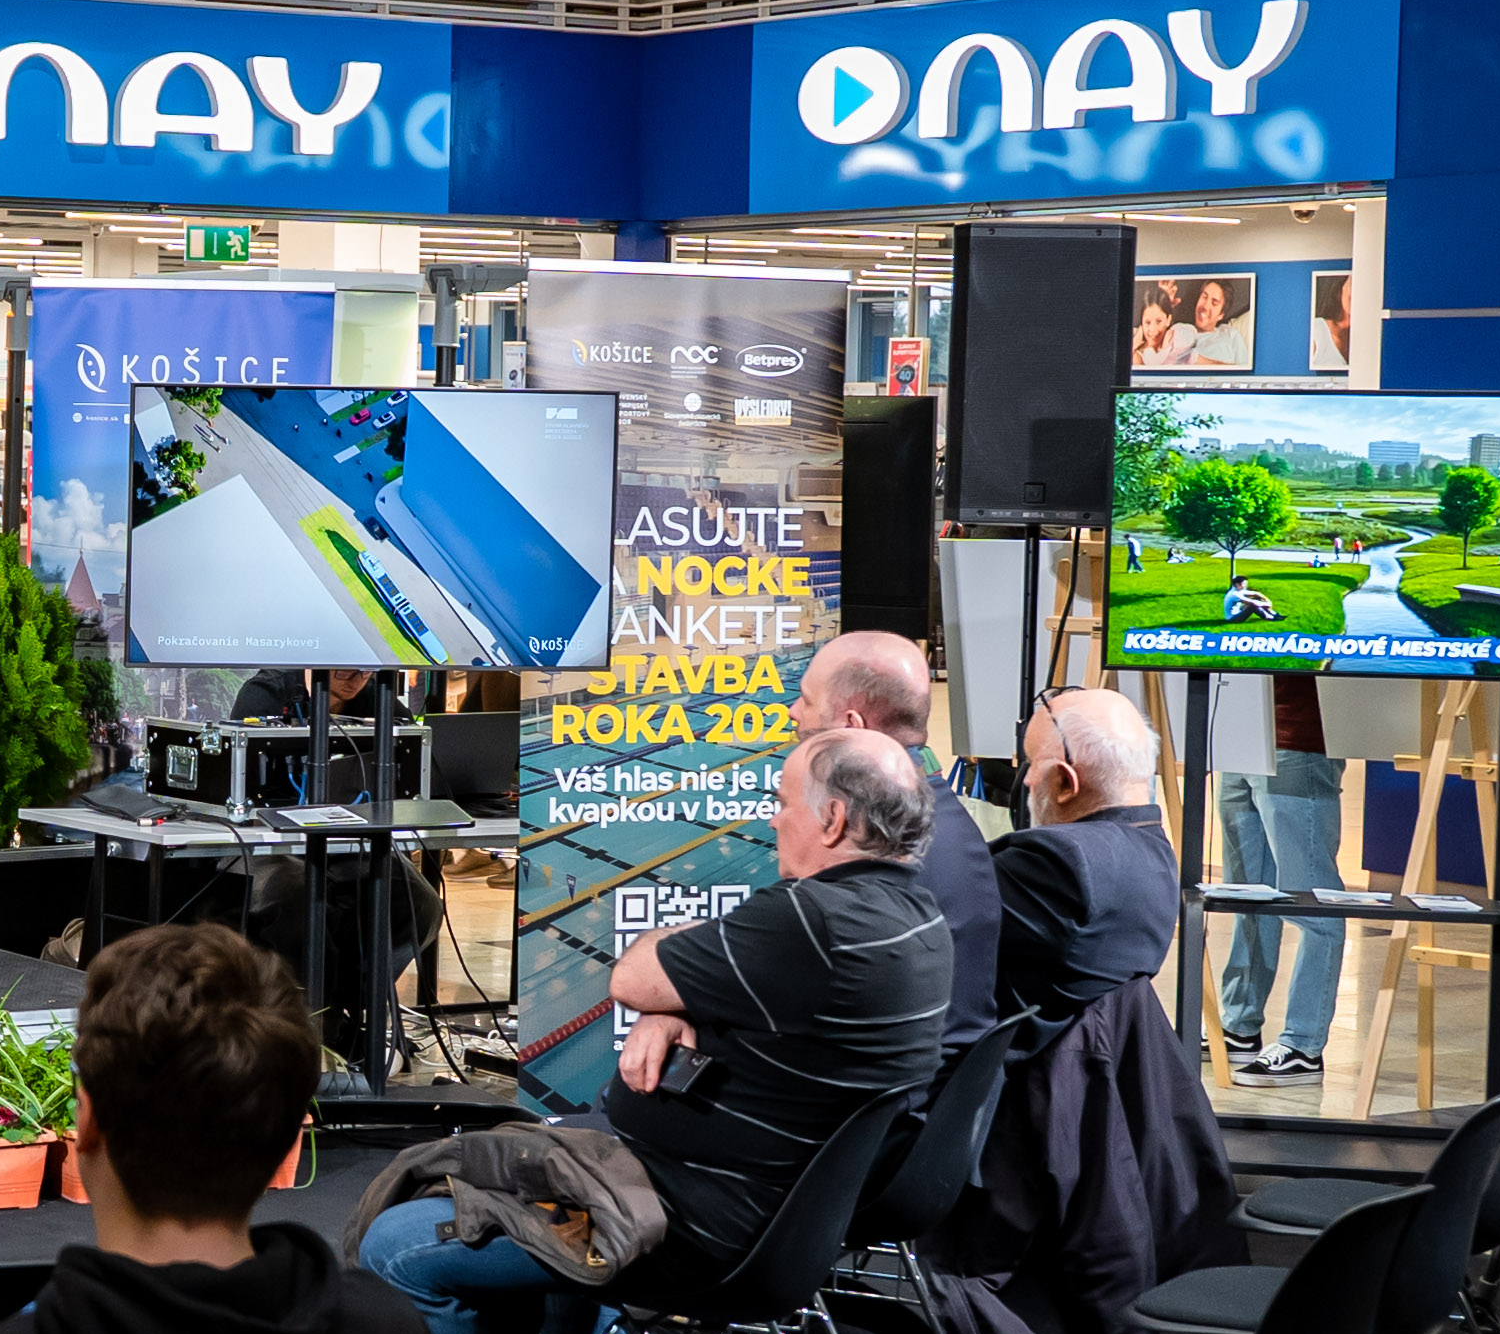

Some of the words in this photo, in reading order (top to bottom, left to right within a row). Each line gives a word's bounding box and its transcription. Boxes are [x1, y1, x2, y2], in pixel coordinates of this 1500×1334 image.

[121, 347, 290, 385] KOŠICE
[590, 341, 653, 364] KOŠICE
[744, 353, 797, 368] Betpres
[637, 555, 811, 597] NOCKE
[611, 605, 801, 646] ANKETE
[157, 635, 239, 647] Pokračovanie
[246, 637, 320, 649] Masarykovej
[541, 636, 584, 651] KOŠICE
[1124, 631, 1204, 652] KOŠICE
[1220, 633, 1321, 655] HORNÁD:
[1325, 634, 1386, 656] NOVÉ
[1390, 637, 1490, 659] MESTSKÉ
[551, 704, 696, 745] ROKA
[705, 703, 799, 744] 202
[553, 765, 607, 793] Váš
[614, 765, 673, 793] hlas
[680, 764, 726, 792] nie
[729, 765, 757, 796] je
[549, 797, 675, 829] kvapkou
[680, 802, 700, 820] v
